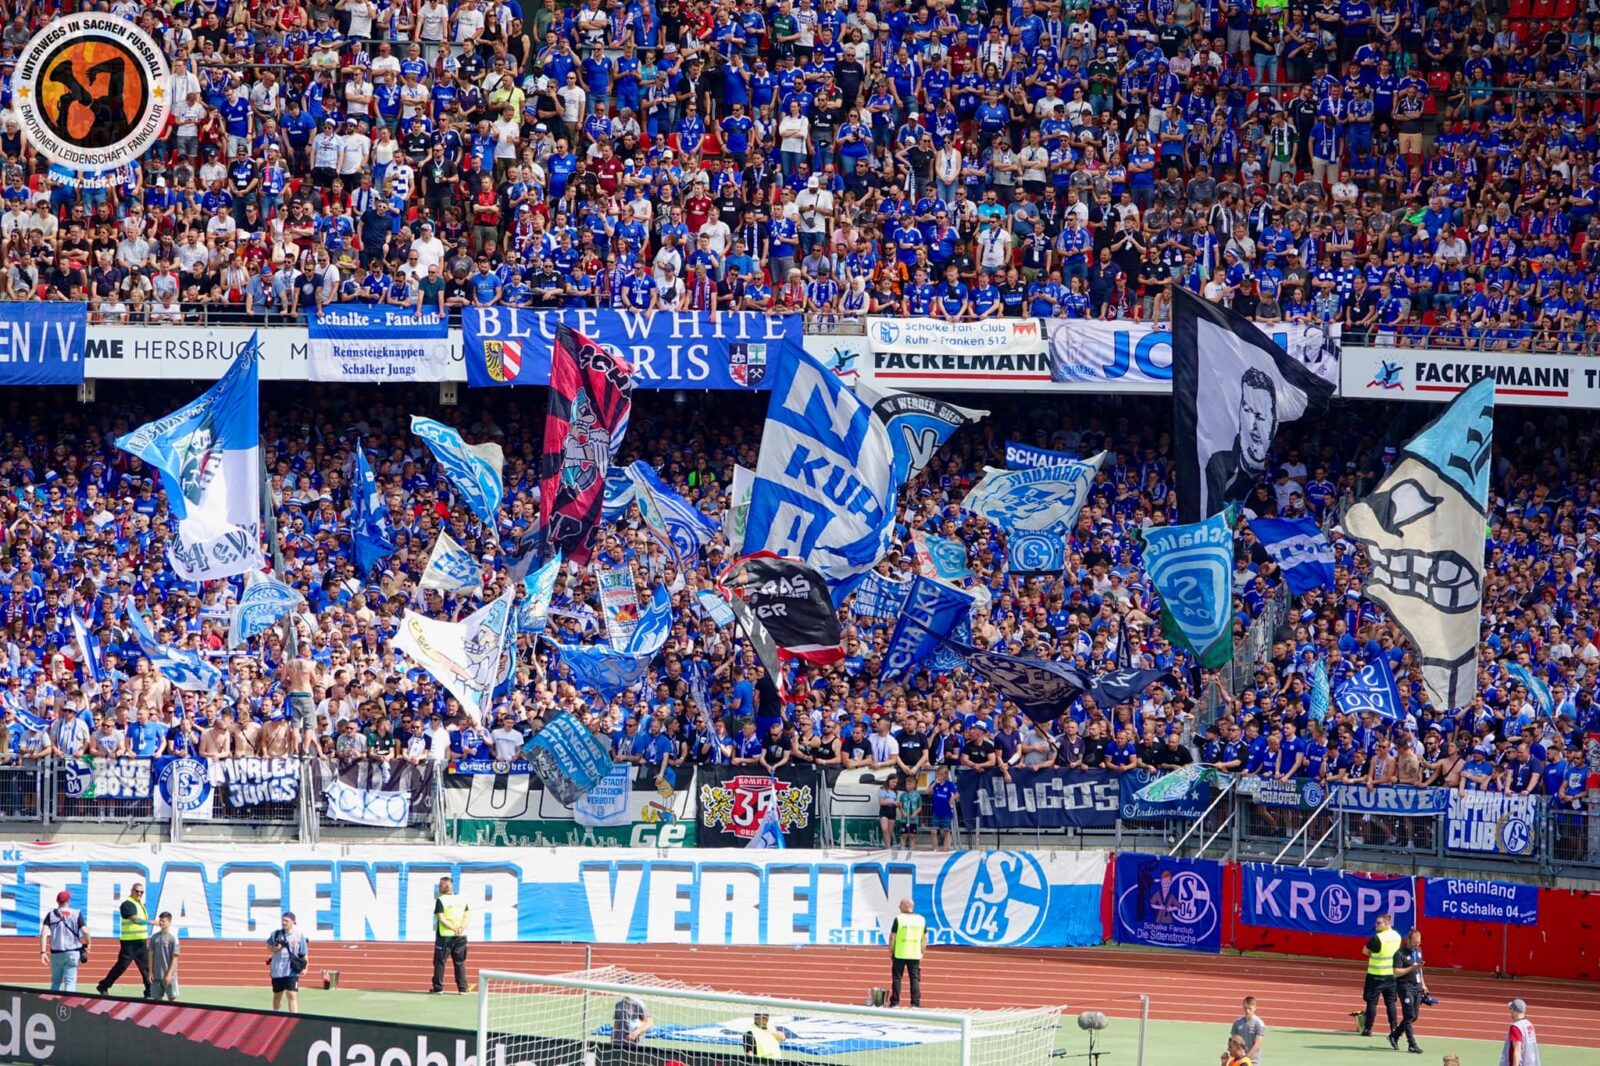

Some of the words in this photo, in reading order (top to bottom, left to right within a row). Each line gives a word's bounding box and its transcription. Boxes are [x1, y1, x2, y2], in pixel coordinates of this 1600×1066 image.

[476, 307, 602, 339] BLUE
[616, 310, 788, 340] WHITE
[980, 322, 1007, 333] Club
[333, 345, 425, 359] Rennsteigknappen
[905, 335, 929, 345] Ruhr
[988, 335, 1007, 346] 512
[342, 363, 385, 375] Schalker
[388, 363, 416, 377] Jungs
[874, 352, 1051, 371] FACKELMANN
[880, 580, 942, 682] SCHALKE
[221, 758, 301, 784] MARLER
[228, 777, 299, 808] JUNGS
[973, 777, 1120, 816] HUGOS
[1447, 787, 1537, 825] SUPPORTERS
[1448, 819, 1497, 851] CLUB
[973, 851, 1018, 904] S
[1447, 879, 1517, 900] Rheinland
[579, 860, 917, 946] VEREIN
[1442, 899, 1458, 914] FC
[1460, 901, 1504, 917] Schalke
[1505, 904, 1520, 918] 04
[965, 900, 999, 941] 04
[1168, 924, 1194, 935] Fanclub
[1136, 928, 1149, 940] Die
